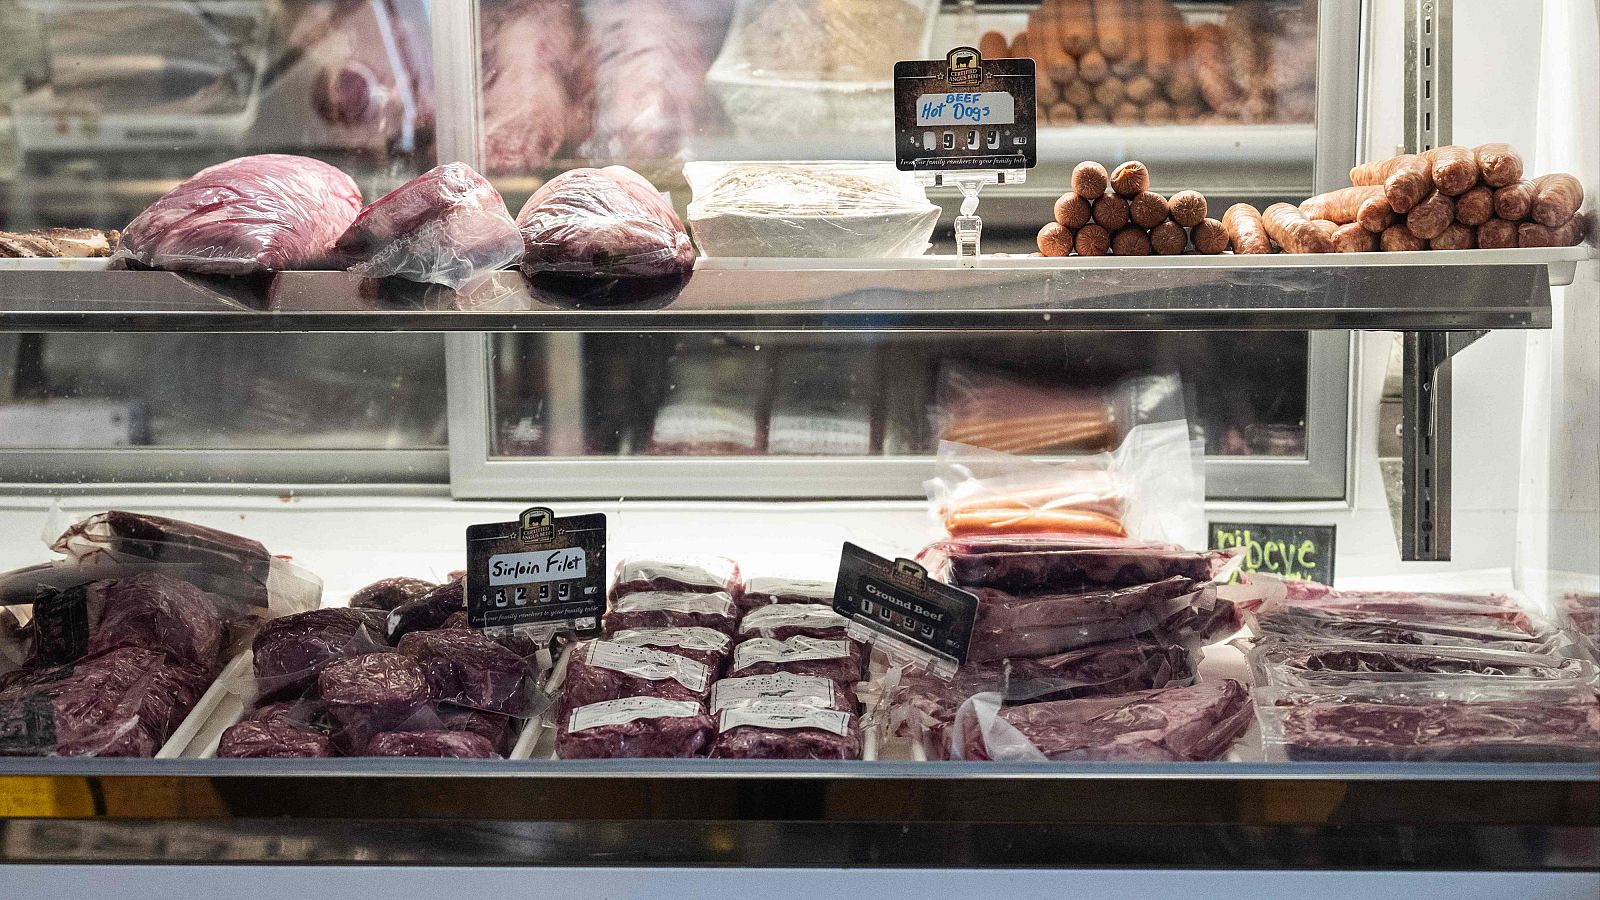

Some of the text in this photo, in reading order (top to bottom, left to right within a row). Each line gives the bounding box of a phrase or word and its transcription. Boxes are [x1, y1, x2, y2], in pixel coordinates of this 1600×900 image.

[945, 93, 982, 104] BEEF
[921, 102, 990, 122] Hot Dogs
[492, 551, 582, 579] Sirloin Filet
[865, 584, 944, 622] Ground Beef
